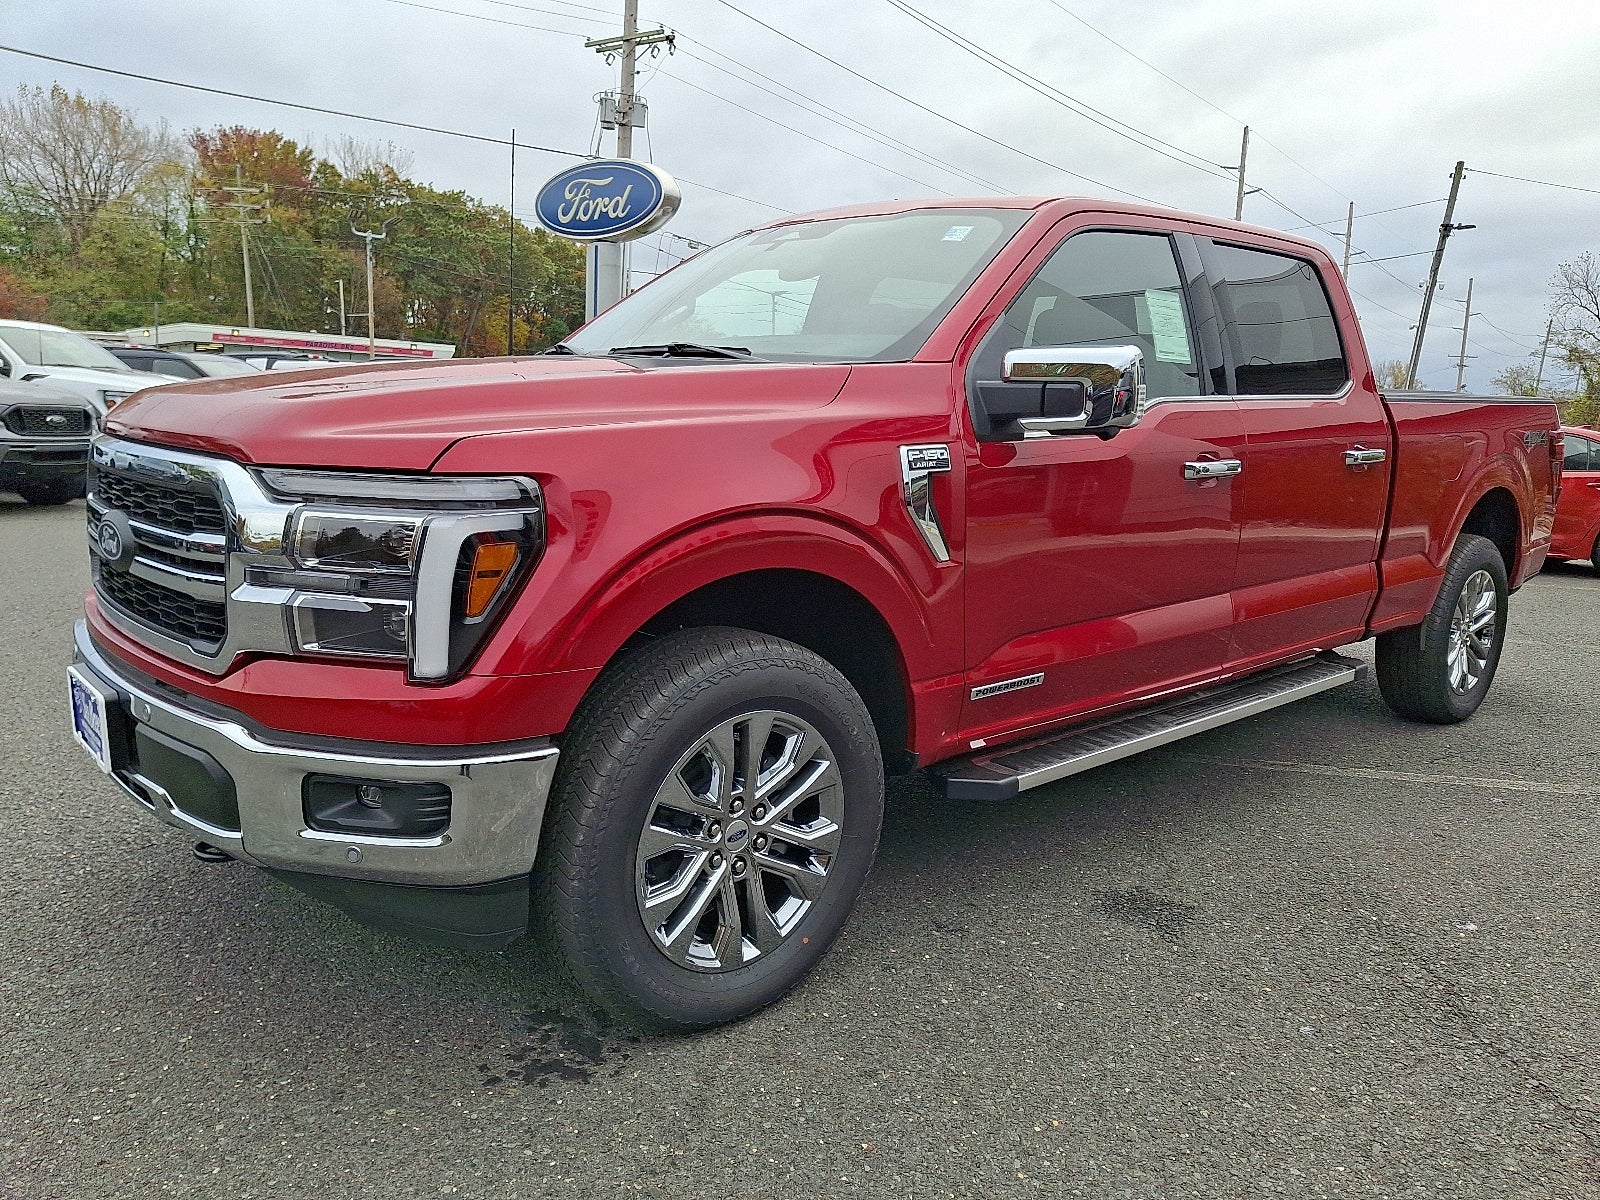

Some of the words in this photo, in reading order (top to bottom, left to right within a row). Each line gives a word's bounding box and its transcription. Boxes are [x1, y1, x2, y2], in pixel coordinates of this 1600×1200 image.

[558, 176, 633, 224] Ford
[908, 449, 948, 461] F-150
[911, 460, 937, 468] LARIAT
[975, 676, 1042, 697] POWERBOOST
